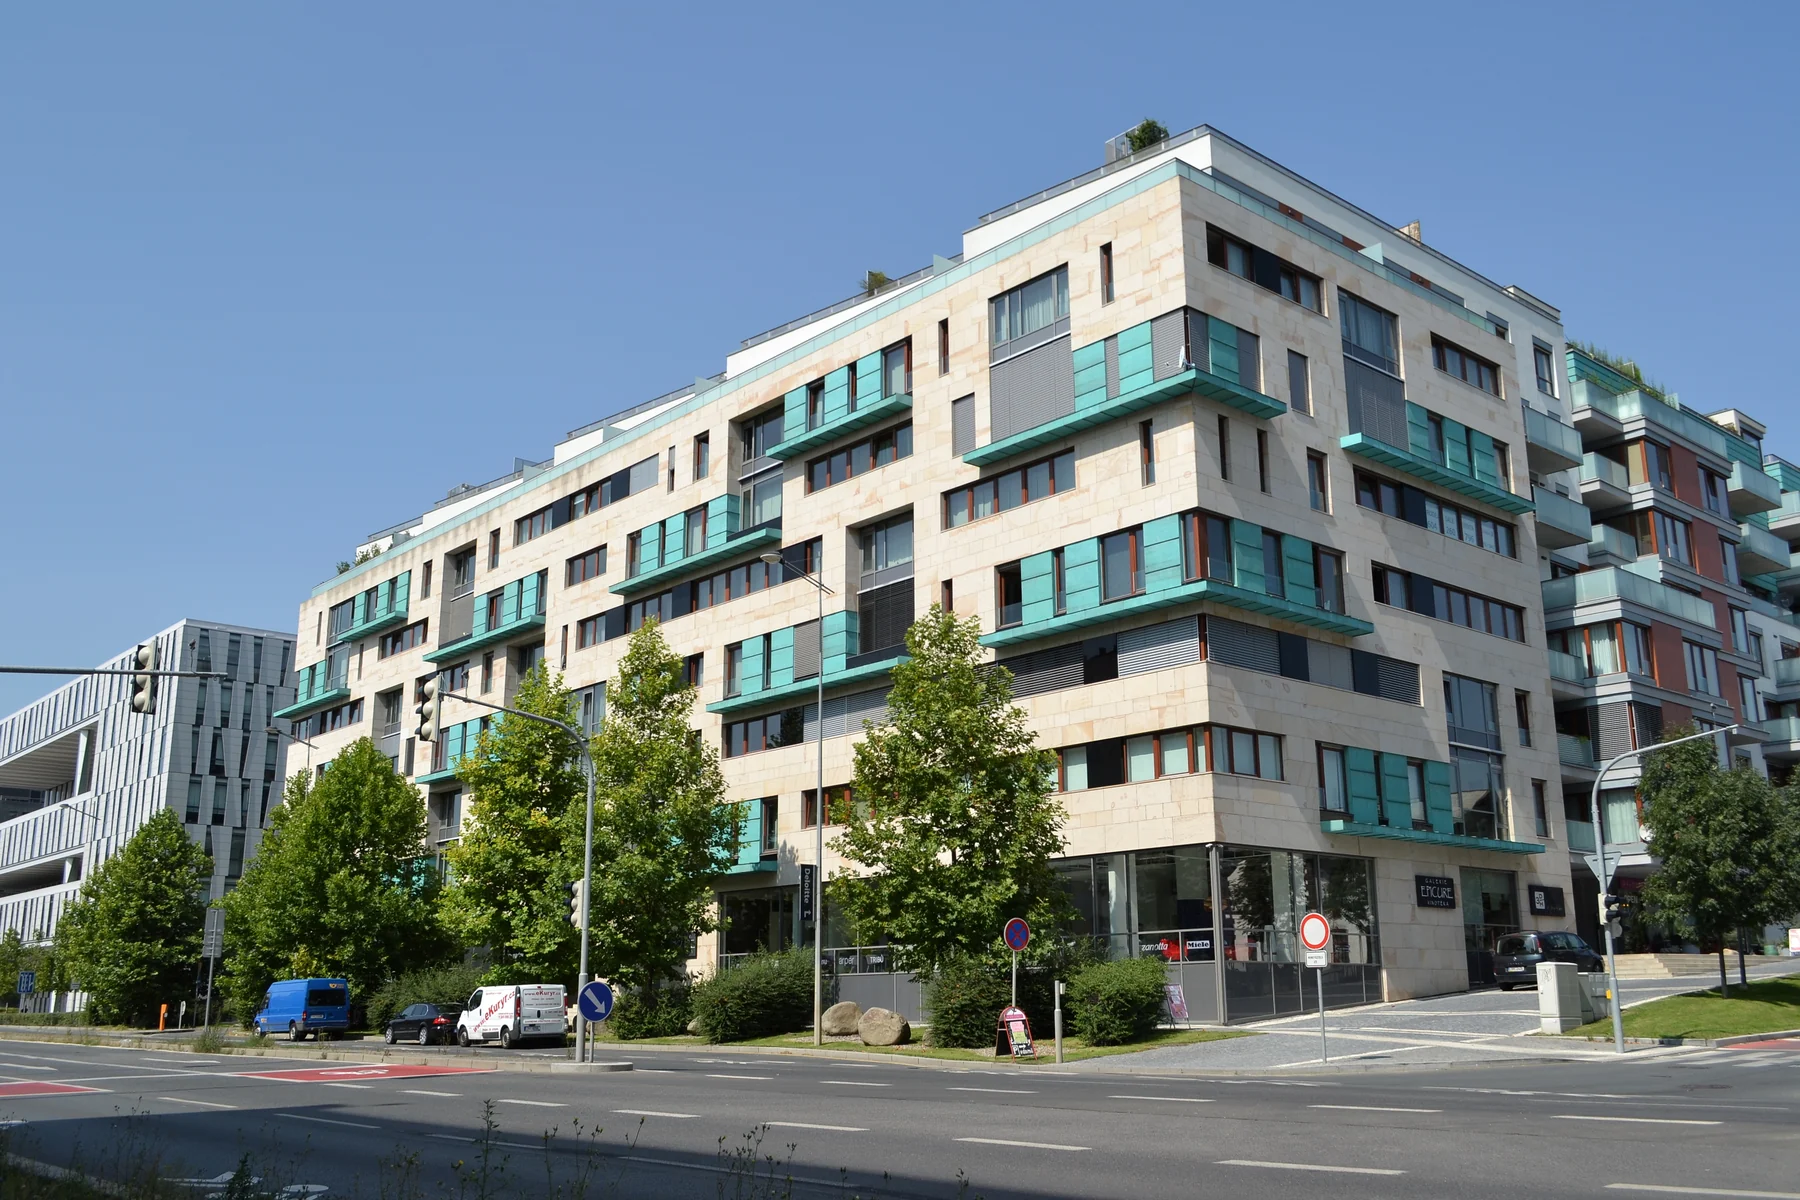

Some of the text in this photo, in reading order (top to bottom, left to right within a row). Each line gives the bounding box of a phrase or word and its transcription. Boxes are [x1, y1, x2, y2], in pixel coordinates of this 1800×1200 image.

[803, 868, 811, 904] Deloitte
[1420, 885, 1454, 899] EPICURE
[1141, 942, 1169, 952] zanotta
[1187, 941, 1210, 949] Miele
[473, 990, 515, 1032] www.eKuryr.cz
